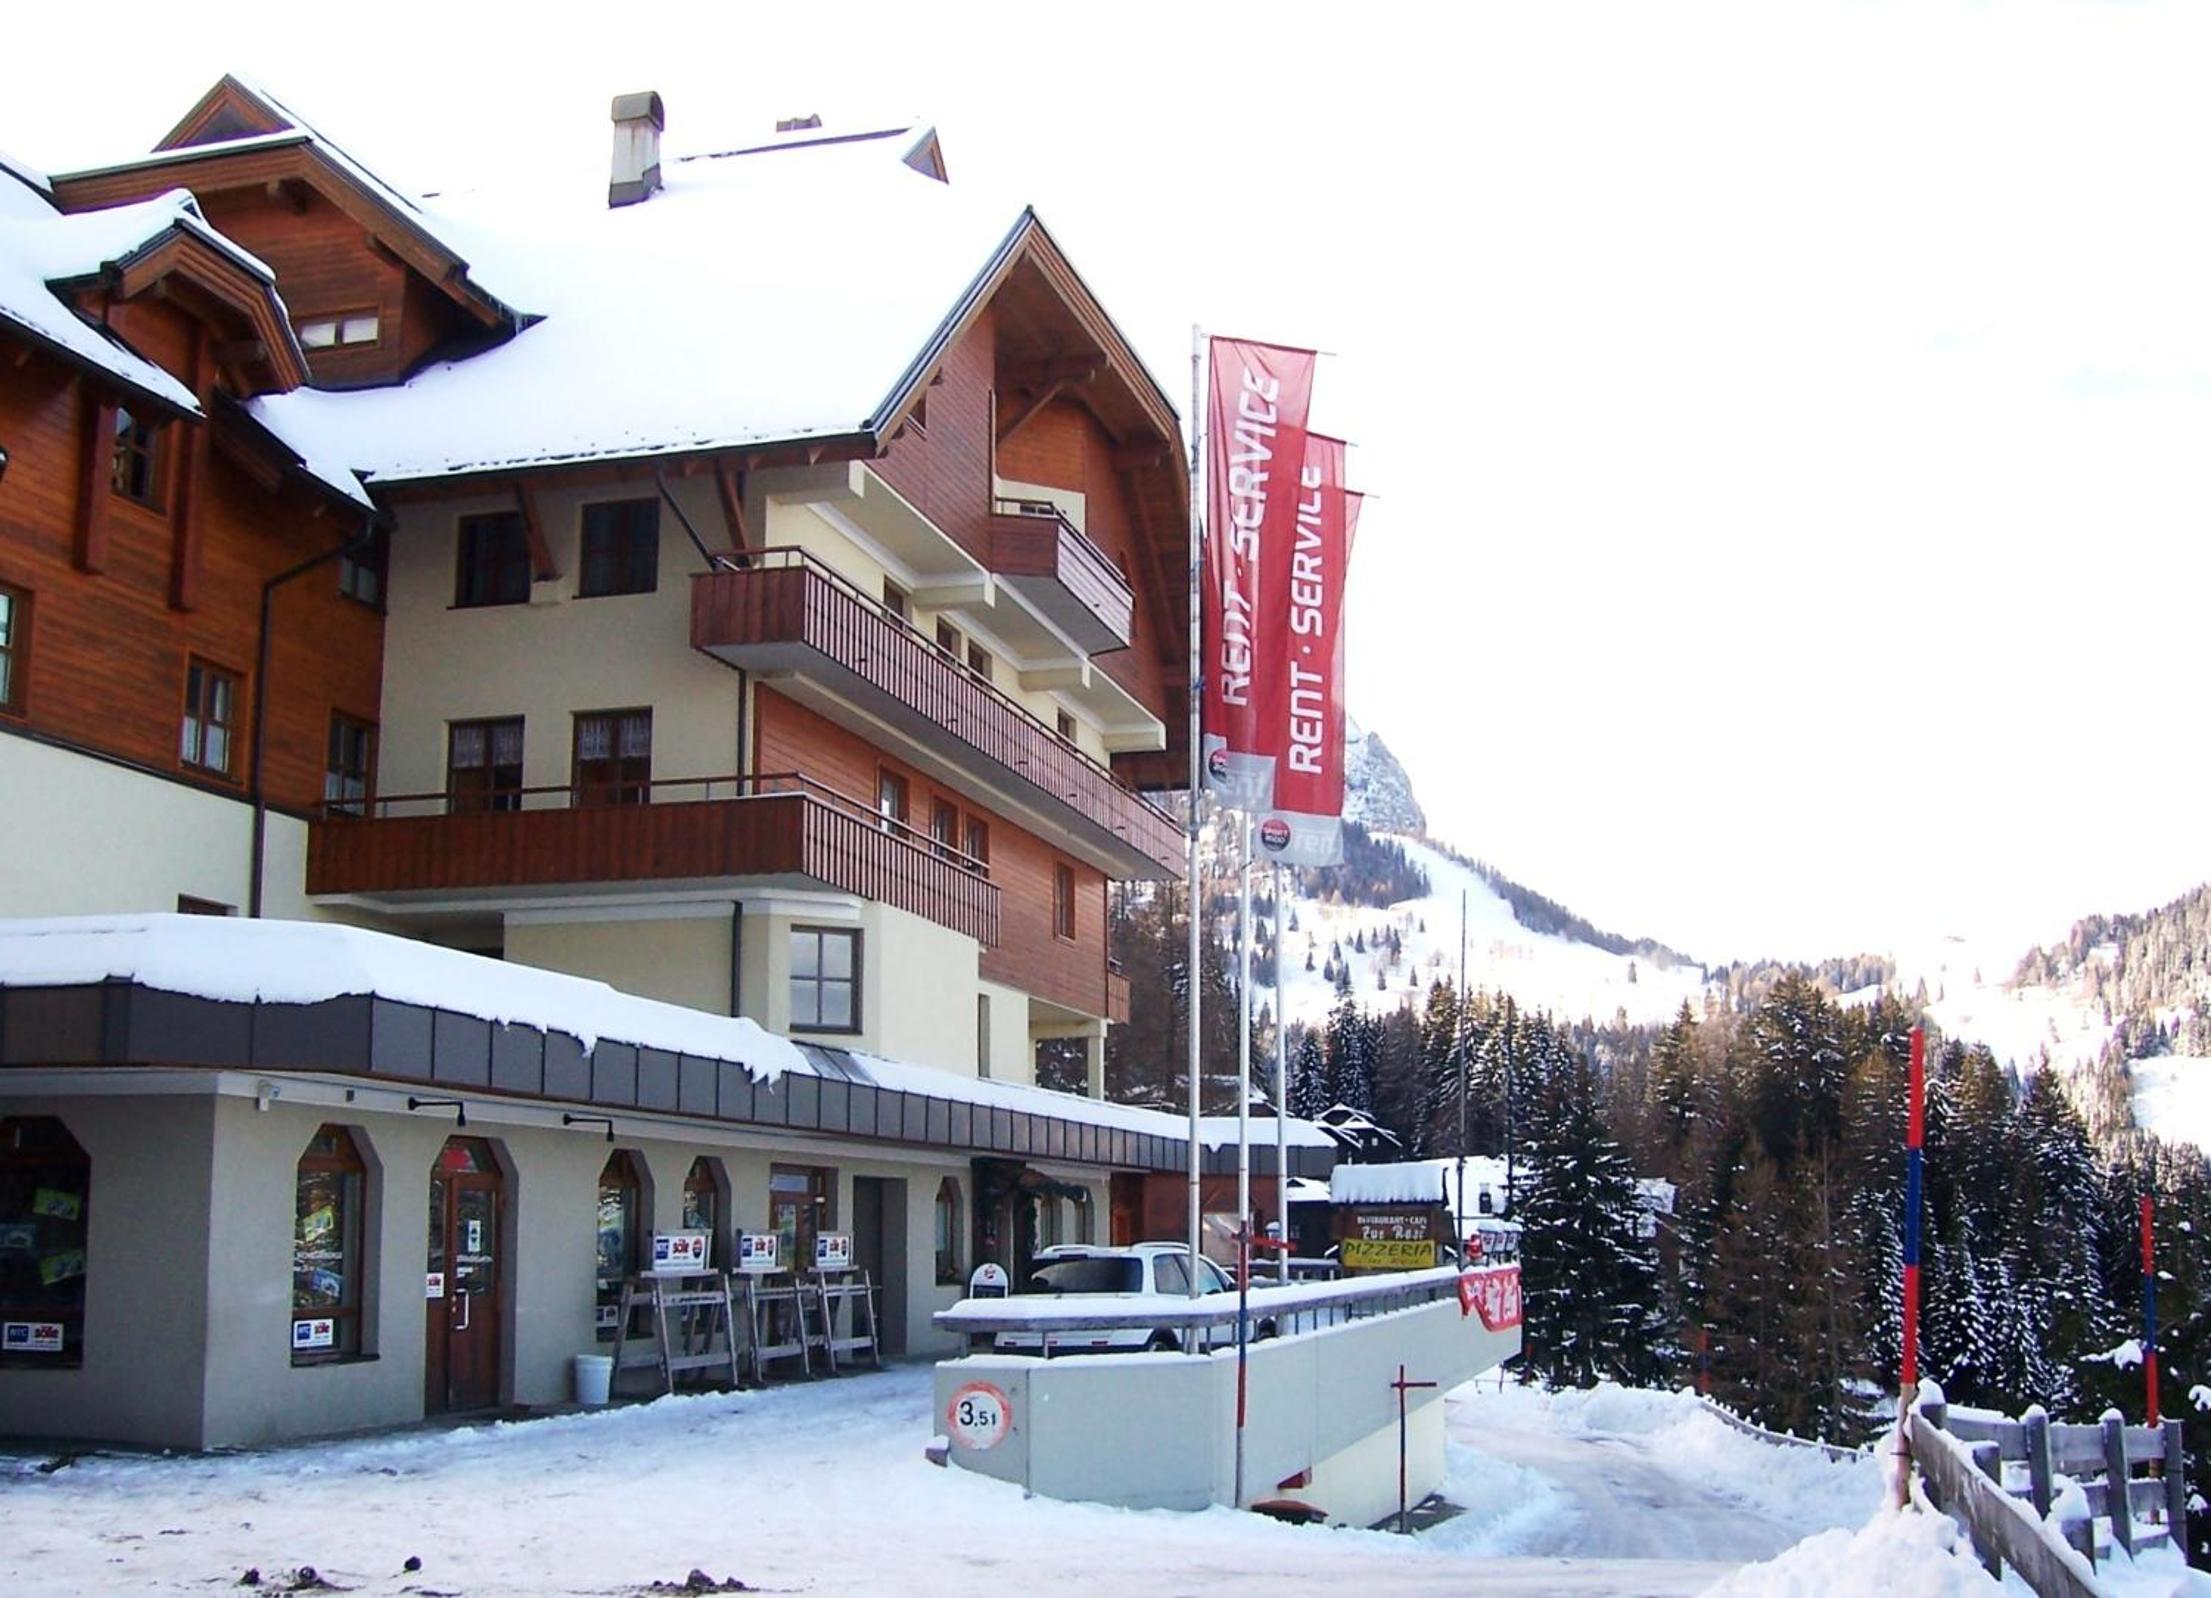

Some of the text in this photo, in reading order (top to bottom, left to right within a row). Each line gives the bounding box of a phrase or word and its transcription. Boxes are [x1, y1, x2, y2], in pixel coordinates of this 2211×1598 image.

[1228, 366, 1280, 562] SERVICE
[1289, 661, 1323, 775] RENT
[1344, 1242, 1432, 1257] PIZZERIA
